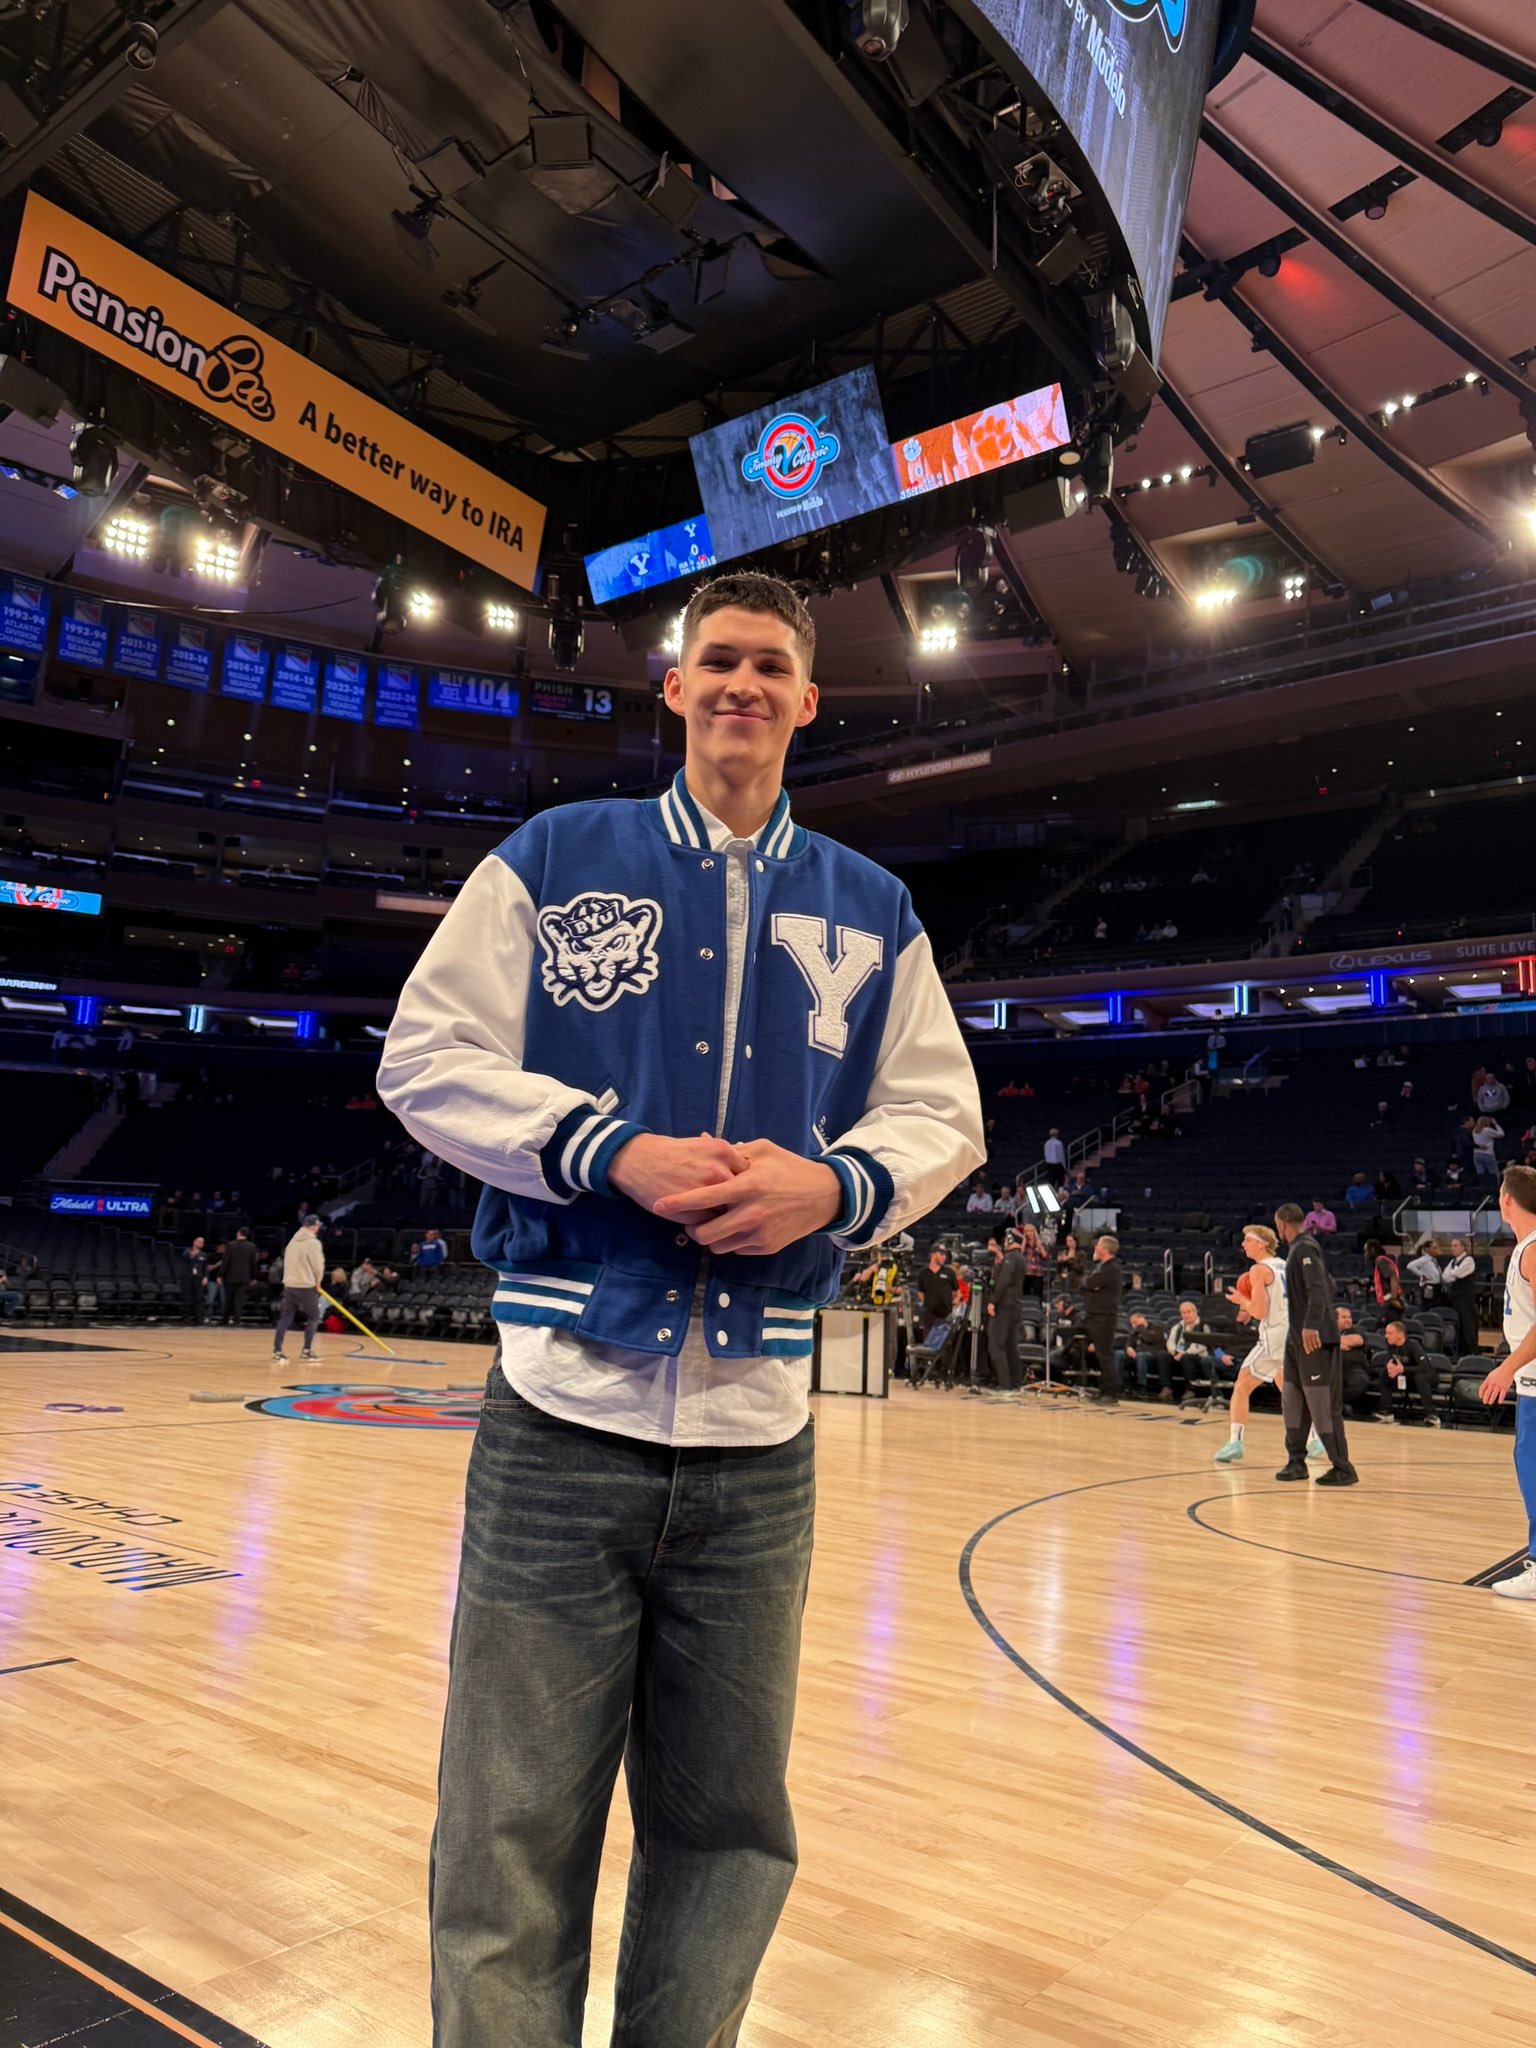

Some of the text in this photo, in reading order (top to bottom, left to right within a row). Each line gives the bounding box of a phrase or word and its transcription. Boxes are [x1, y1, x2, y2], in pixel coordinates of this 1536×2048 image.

[1087, 14, 1126, 119] Modelo
[38, 245, 275, 422] PensionBee
[792, 445, 829, 468] Classic
[298, 400, 524, 552] A better way to IRA
[684, 523, 697, 538] Y
[690, 543, 699, 556] 0
[630, 552, 650, 576] Y
[3, 606, 46, 626] 1993-94
[4, 619, 41, 634] ATLANTIC
[5, 627, 38, 642] DIVISION
[64, 622, 107, 640] 1993-94
[465, 676, 510, 708] 104
[534, 682, 573, 695] PHISH
[583, 688, 612, 714] 13
[574, 909, 615, 934] BYU
[1357, 950, 1433, 967] LEXUS
[1456, 940, 1536, 958] SUITE LEVE
[771, 913, 884, 1060] Y
[106, 1200, 150, 1212] ULTRA
[12, 1489, 183, 1527] CHASE
[0, 1527, 243, 1592] MADISON
